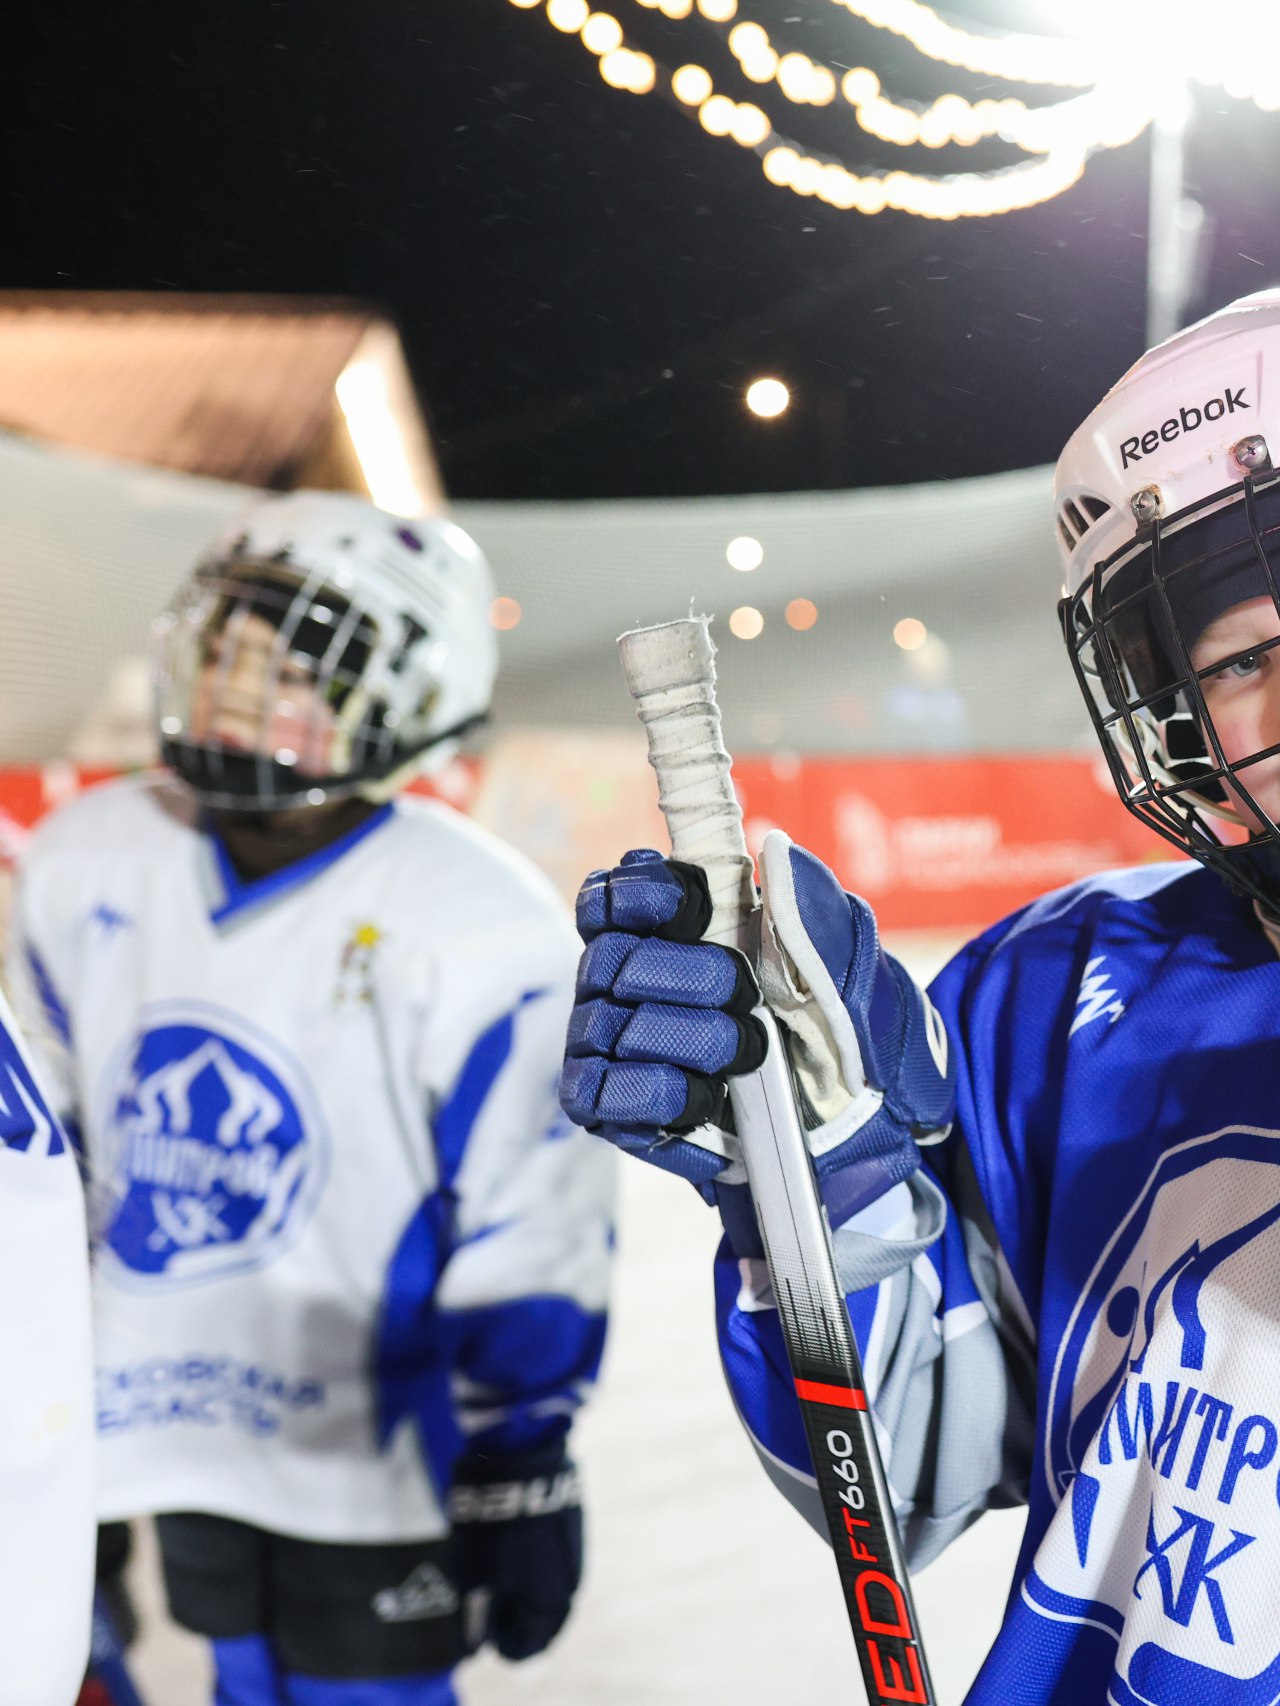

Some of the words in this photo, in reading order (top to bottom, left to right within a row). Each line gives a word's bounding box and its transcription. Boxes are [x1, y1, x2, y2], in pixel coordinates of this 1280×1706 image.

[1119, 387, 1251, 470] Reebok
[1133, 1491, 1257, 1645] ХК
[855, 1569, 928, 1706] ED
